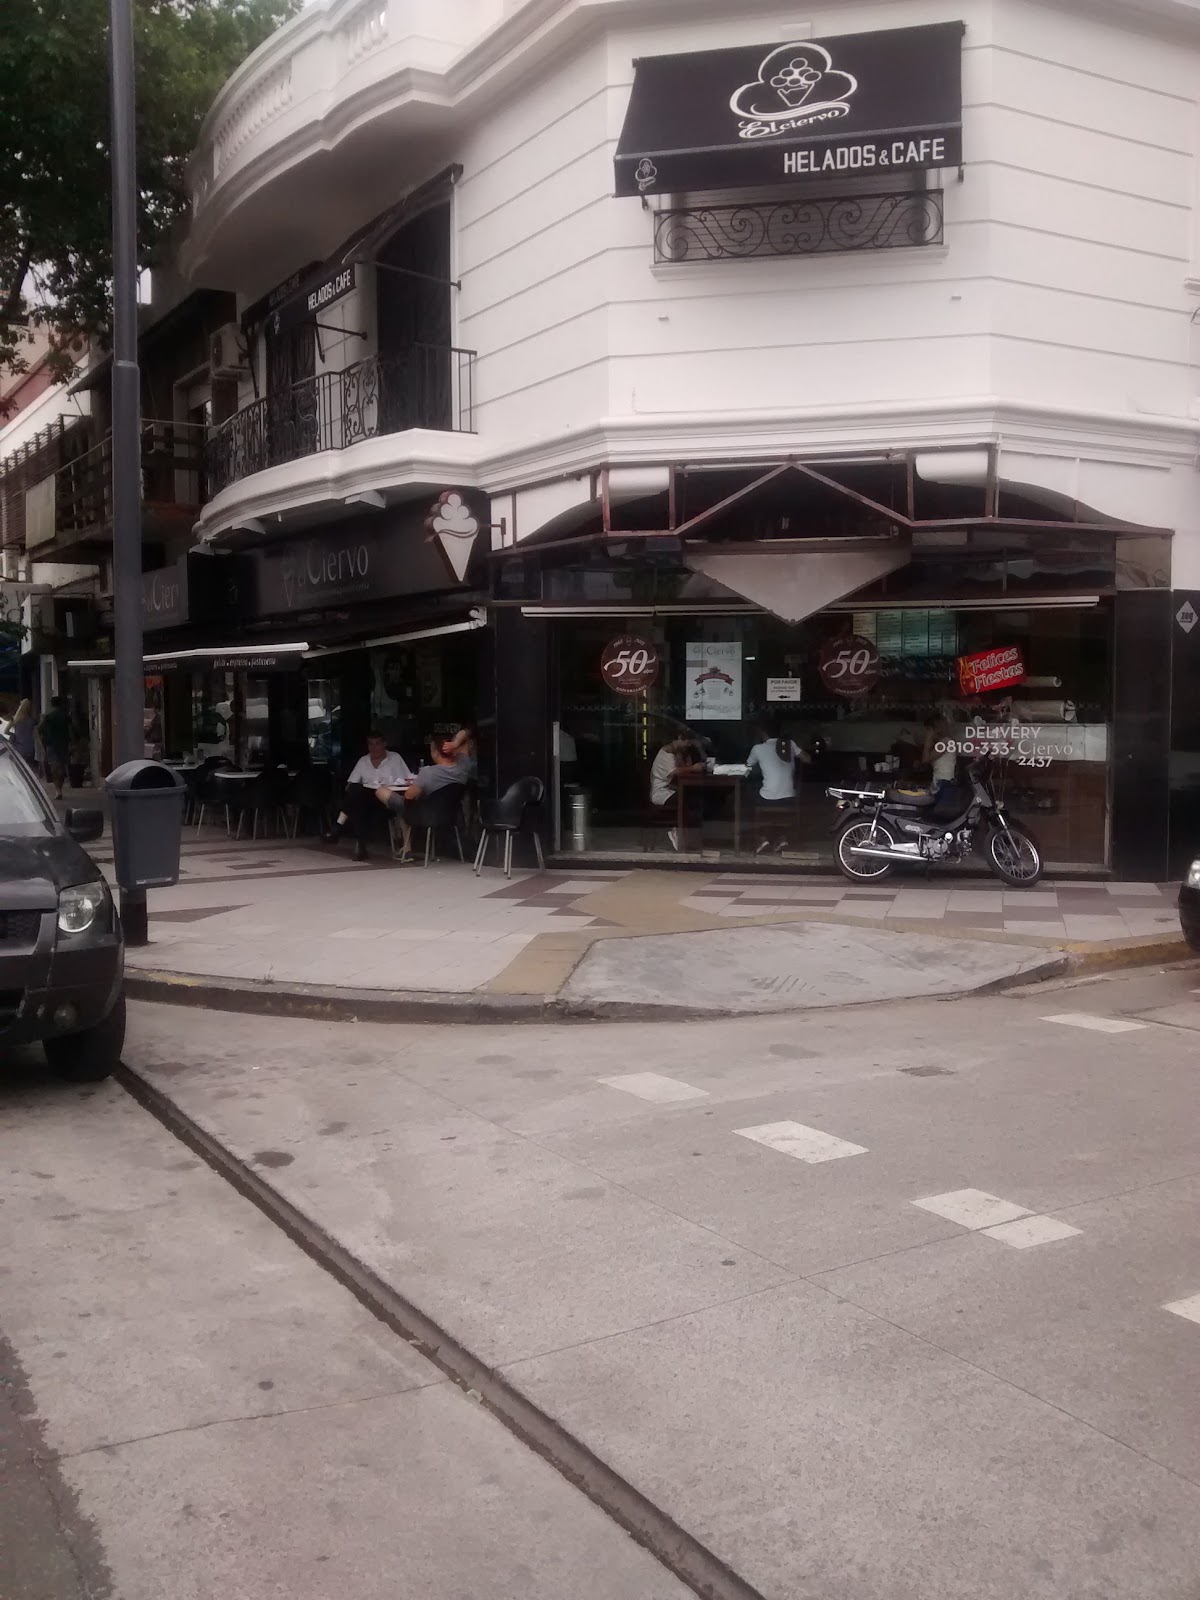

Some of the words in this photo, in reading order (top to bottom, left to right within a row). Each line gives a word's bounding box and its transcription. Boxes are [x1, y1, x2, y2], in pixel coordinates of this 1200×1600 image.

[783, 145, 876, 173] HELADOS
[879, 150, 889, 166] &
[892, 138, 945, 163] CAFE
[307, 281, 333, 311] HELADOS
[335, 269, 351, 294] CAFE
[306, 545, 369, 585] Ciervo
[609, 649, 650, 677] 50
[829, 649, 871, 679] 50
[972, 647, 1019, 675] Felices
[974, 662, 1024, 690] Fiestas
[965, 726, 1041, 739] DELIVERY
